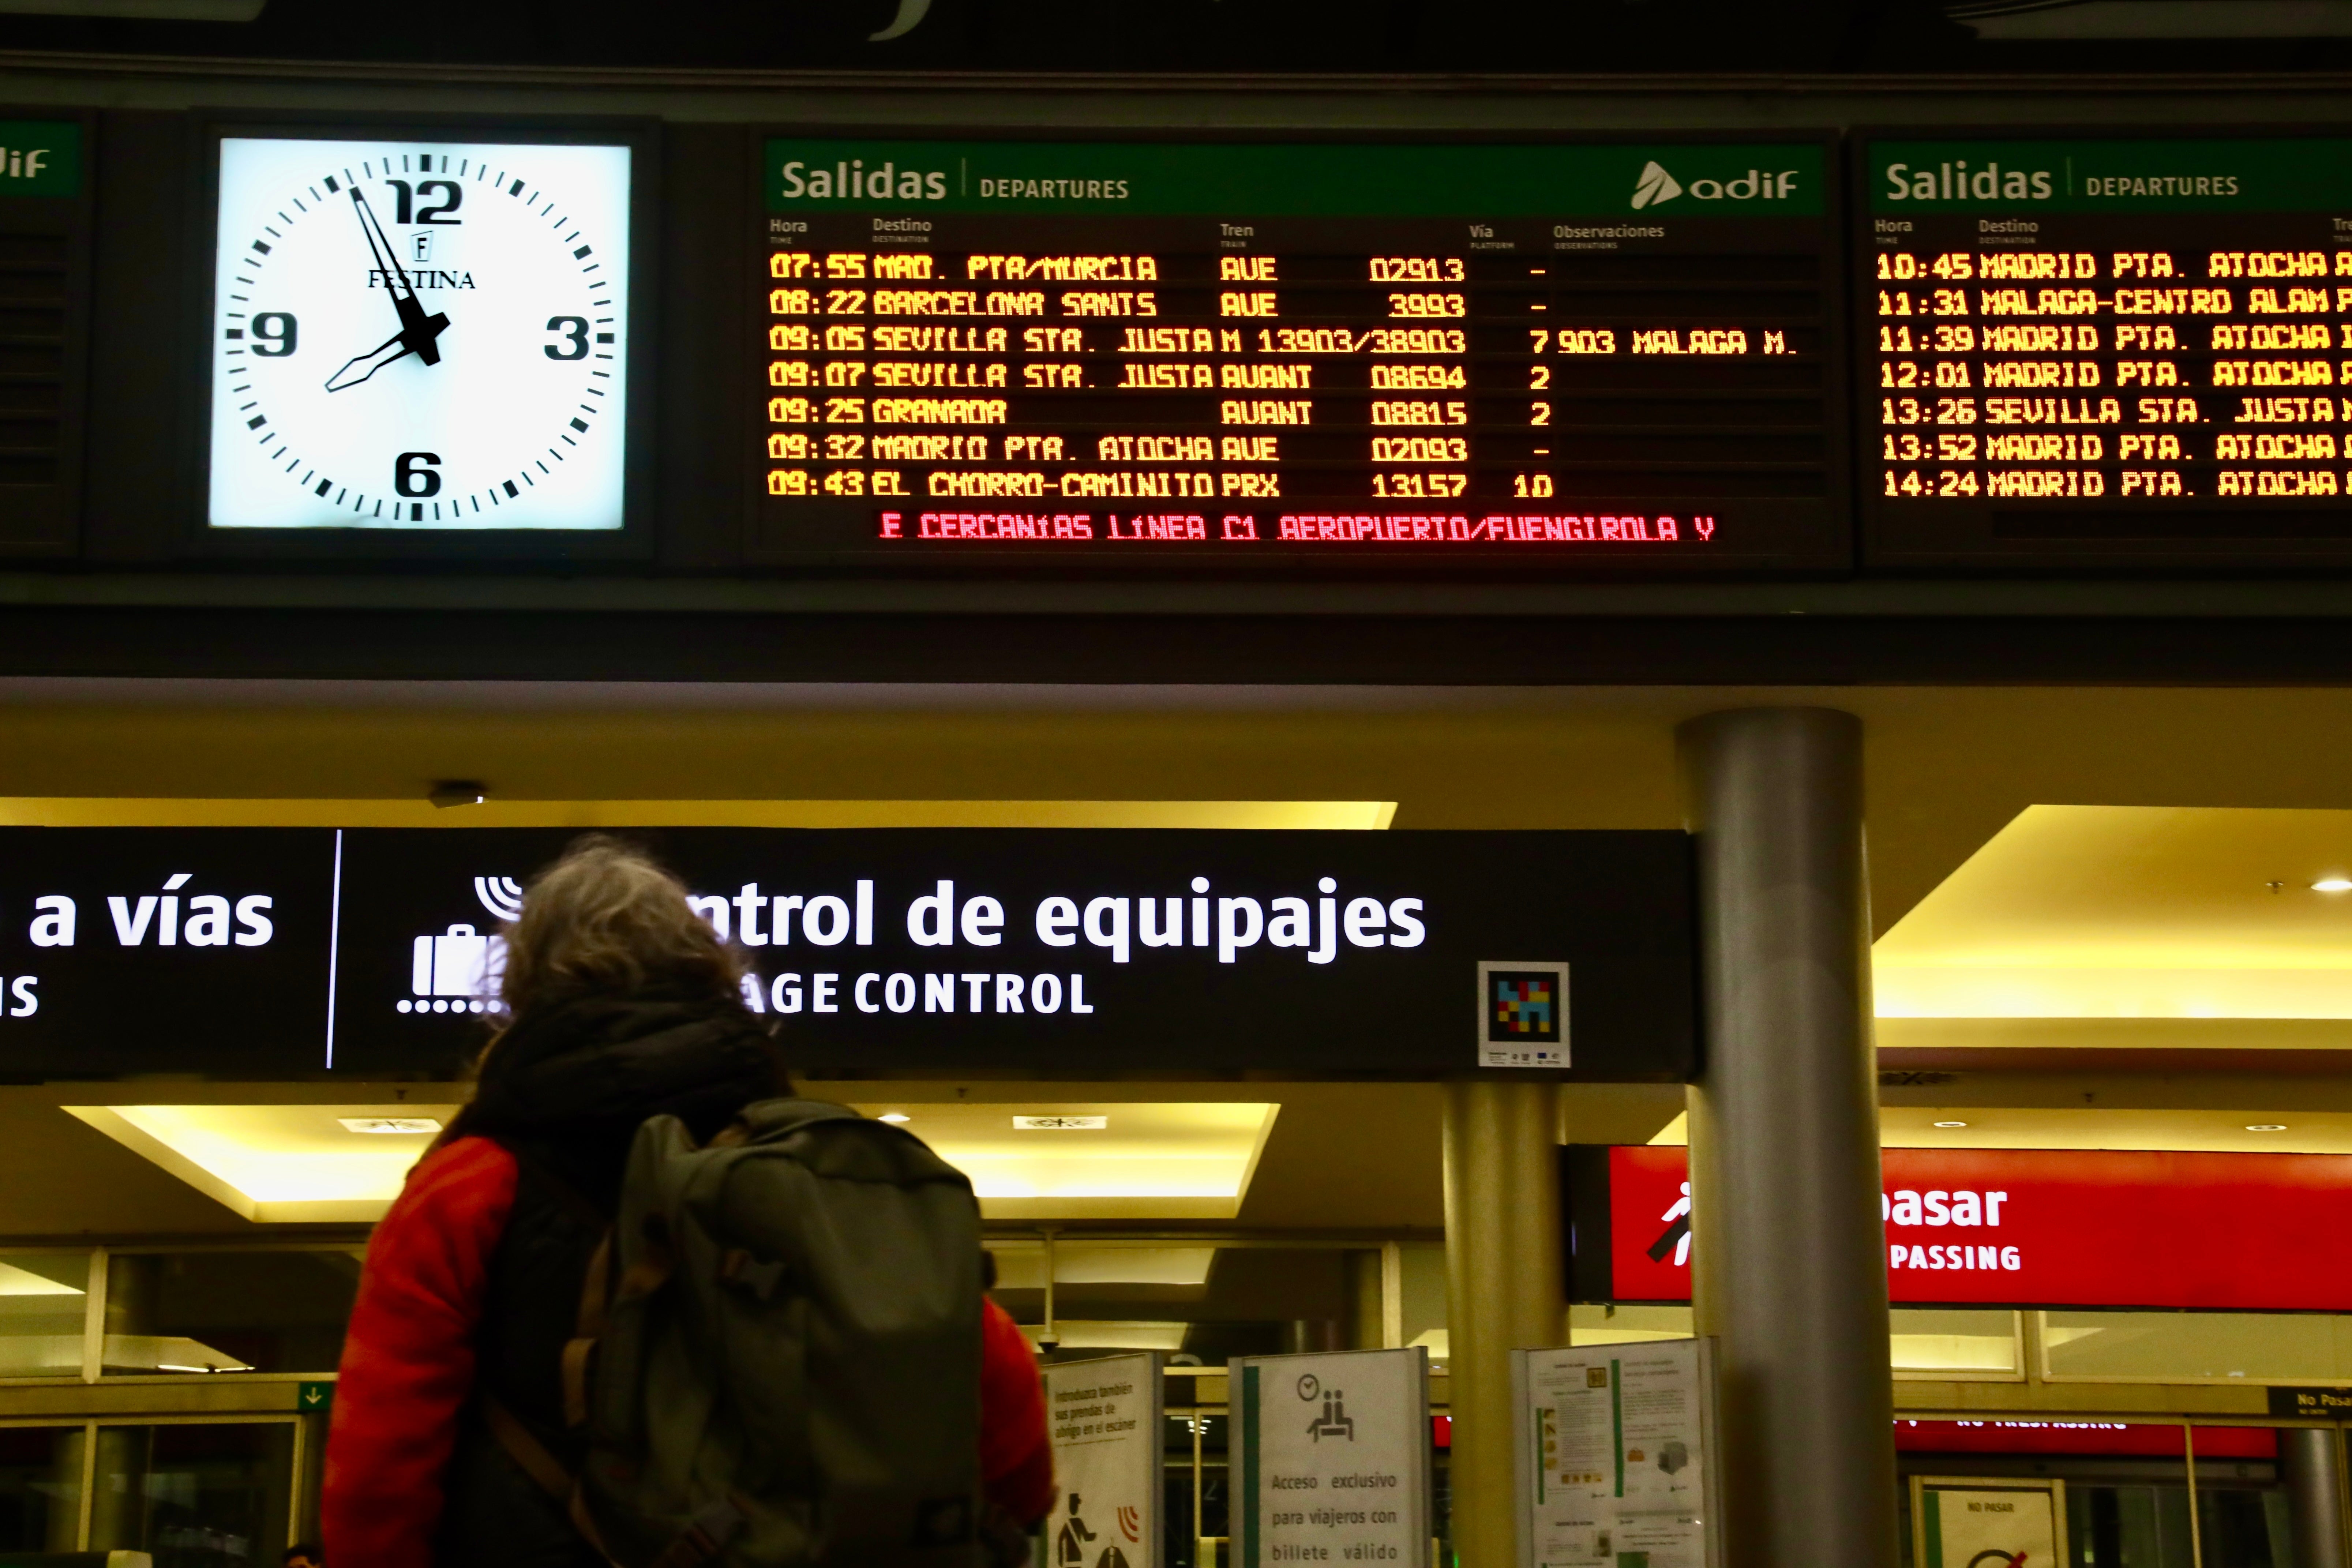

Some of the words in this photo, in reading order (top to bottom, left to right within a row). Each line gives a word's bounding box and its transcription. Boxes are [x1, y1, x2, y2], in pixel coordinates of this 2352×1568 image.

[783, 160, 946, 199] Salidas
[981, 179, 1128, 199] DEPARTURES
[1690, 170, 1798, 199] adif
[1887, 160, 2052, 200] Salidas
[2087, 176, 2238, 196] DEPARTURES
[386, 180, 462, 225] 12
[770, 219, 807, 232] Hora
[873, 218, 933, 232] Destino
[1220, 223, 1254, 236] Tren
[1468, 224, 1494, 238] Vía
[1553, 224, 1665, 238] Observaciones
[1875, 220, 1913, 232] Hora
[1978, 219, 2039, 232] Destino
[770, 253, 866, 278] 07:55
[873, 254, 945, 279] MAD.
[967, 256, 1157, 280] PTA/MURCIA
[1220, 257, 1278, 280] AVE
[1369, 258, 1464, 281] 02913
[1878, 253, 1973, 279] 10:45
[1980, 253, 2096, 279] MADRID
[2113, 253, 2184, 278] PTA.
[2209, 252, 2328, 277] ATOCHA
[770, 289, 866, 314] 08:22
[873, 290, 1044, 315] BARCELONA
[1061, 292, 1157, 316] SANTS
[1220, 292, 1278, 316] AVE
[1389, 294, 1465, 317] 3993
[1879, 289, 1969, 315] 11:31
[1981, 289, 2232, 315] MALAGA-CENTRO
[2249, 288, 2330, 313] ALAM
[252, 312, 297, 357] 9
[544, 316, 589, 360] 3
[769, 324, 865, 350] 09:05
[873, 326, 1007, 351] SEVILLA
[1024, 328, 1094, 352] STA.
[1118, 328, 1213, 352] JUSTA
[1221, 329, 1241, 352] M
[1258, 329, 1466, 353] 13903/38903
[1530, 330, 1548, 353] 7
[1558, 330, 1616, 353] 903
[1632, 330, 1747, 354] MALAGA
[1764, 331, 1796, 354] M.
[1880, 325, 1975, 351] 11:39
[1982, 325, 2098, 351] MADRID
[2115, 326, 2187, 350] PTA.
[2212, 325, 2331, 349] ATOCHA
[769, 361, 866, 386] 09:07
[872, 362, 1007, 387] SEVILLA
[1024, 364, 1094, 387] STA.
[1118, 364, 1213, 388] JUSTA
[1221, 364, 1312, 388] AVANT
[1371, 365, 1466, 389] 08694
[1530, 366, 1549, 389] 2
[1882, 361, 1971, 387] 12:01
[1984, 362, 2100, 387] MADRID
[2117, 362, 2189, 386] PTA.
[2213, 361, 2333, 386] ATOCHA
[769, 398, 864, 423] 09:25
[872, 398, 1007, 424] GRANADA
[1221, 401, 1312, 424] AVANT
[1371, 401, 1467, 425] 08815
[1531, 402, 1550, 425] 2
[1883, 398, 1977, 424] 13:26
[1985, 397, 2120, 424] SEVILLA
[2139, 398, 2209, 423] STA.
[2235, 398, 2334, 422] JUSTA
[768, 434, 864, 459] 09:32
[871, 435, 987, 460] MADRID
[1004, 436, 1076, 460] PTA.
[1099, 436, 1214, 461] ATOCHA
[1221, 437, 1279, 461] AVE
[1372, 438, 1468, 461] 02093
[1884, 434, 1977, 460] 13:52
[1986, 435, 2102, 460] MADRID
[2120, 435, 2192, 459] PTA.
[2216, 434, 2336, 459] ATOCHA
[395, 452, 441, 497] 6
[768, 469, 864, 495] 09:43
[871, 471, 910, 495] EL
[929, 472, 1214, 496] CHORRO-CAMINITO
[1222, 473, 1280, 497] PRX
[1372, 474, 1467, 497] 13157
[1514, 475, 1553, 497] 10
[1885, 470, 1980, 496] 14:24
[1987, 470, 2104, 496] MADRID
[2122, 472, 2194, 496] PTA.
[2218, 471, 2337, 495] ATOCHA
[879, 512, 903, 538] E
[1220, 515, 1260, 540] C1
[1277, 515, 1678, 541] AEROPUERTO/FUENGIROLA
[1695, 517, 1714, 541] Y
[30, 895, 76, 947] a
[107, 874, 273, 947] vías
[685, 879, 873, 946] ntrol
[907, 880, 1004, 946] de
[1036, 877, 1425, 963] equipajes
[0, 976, 38, 1017] S
[740, 973, 839, 1013] AGE
[855, 973, 1094, 1013] CONTROL
[1890, 1245, 2021, 1271] PASSING
[1105, 1403, 1115, 1414] de
[2297, 1393, 2316, 1406] No
[2321, 1394, 2352, 1406] Pasa
[1272, 1475, 1317, 1489] Acceso
[1331, 1471, 1396, 1488] exclusivo
[1272, 1512, 1304, 1528] para
[1309, 1508, 1365, 1528] viajeros
[1371, 1511, 1396, 1523] con
[1967, 1502, 1982, 1512] NO
[1984, 1502, 2014, 1512] PASAR
[1272, 1545, 1328, 1560] billete
[1343, 1542, 1398, 1560] válido
